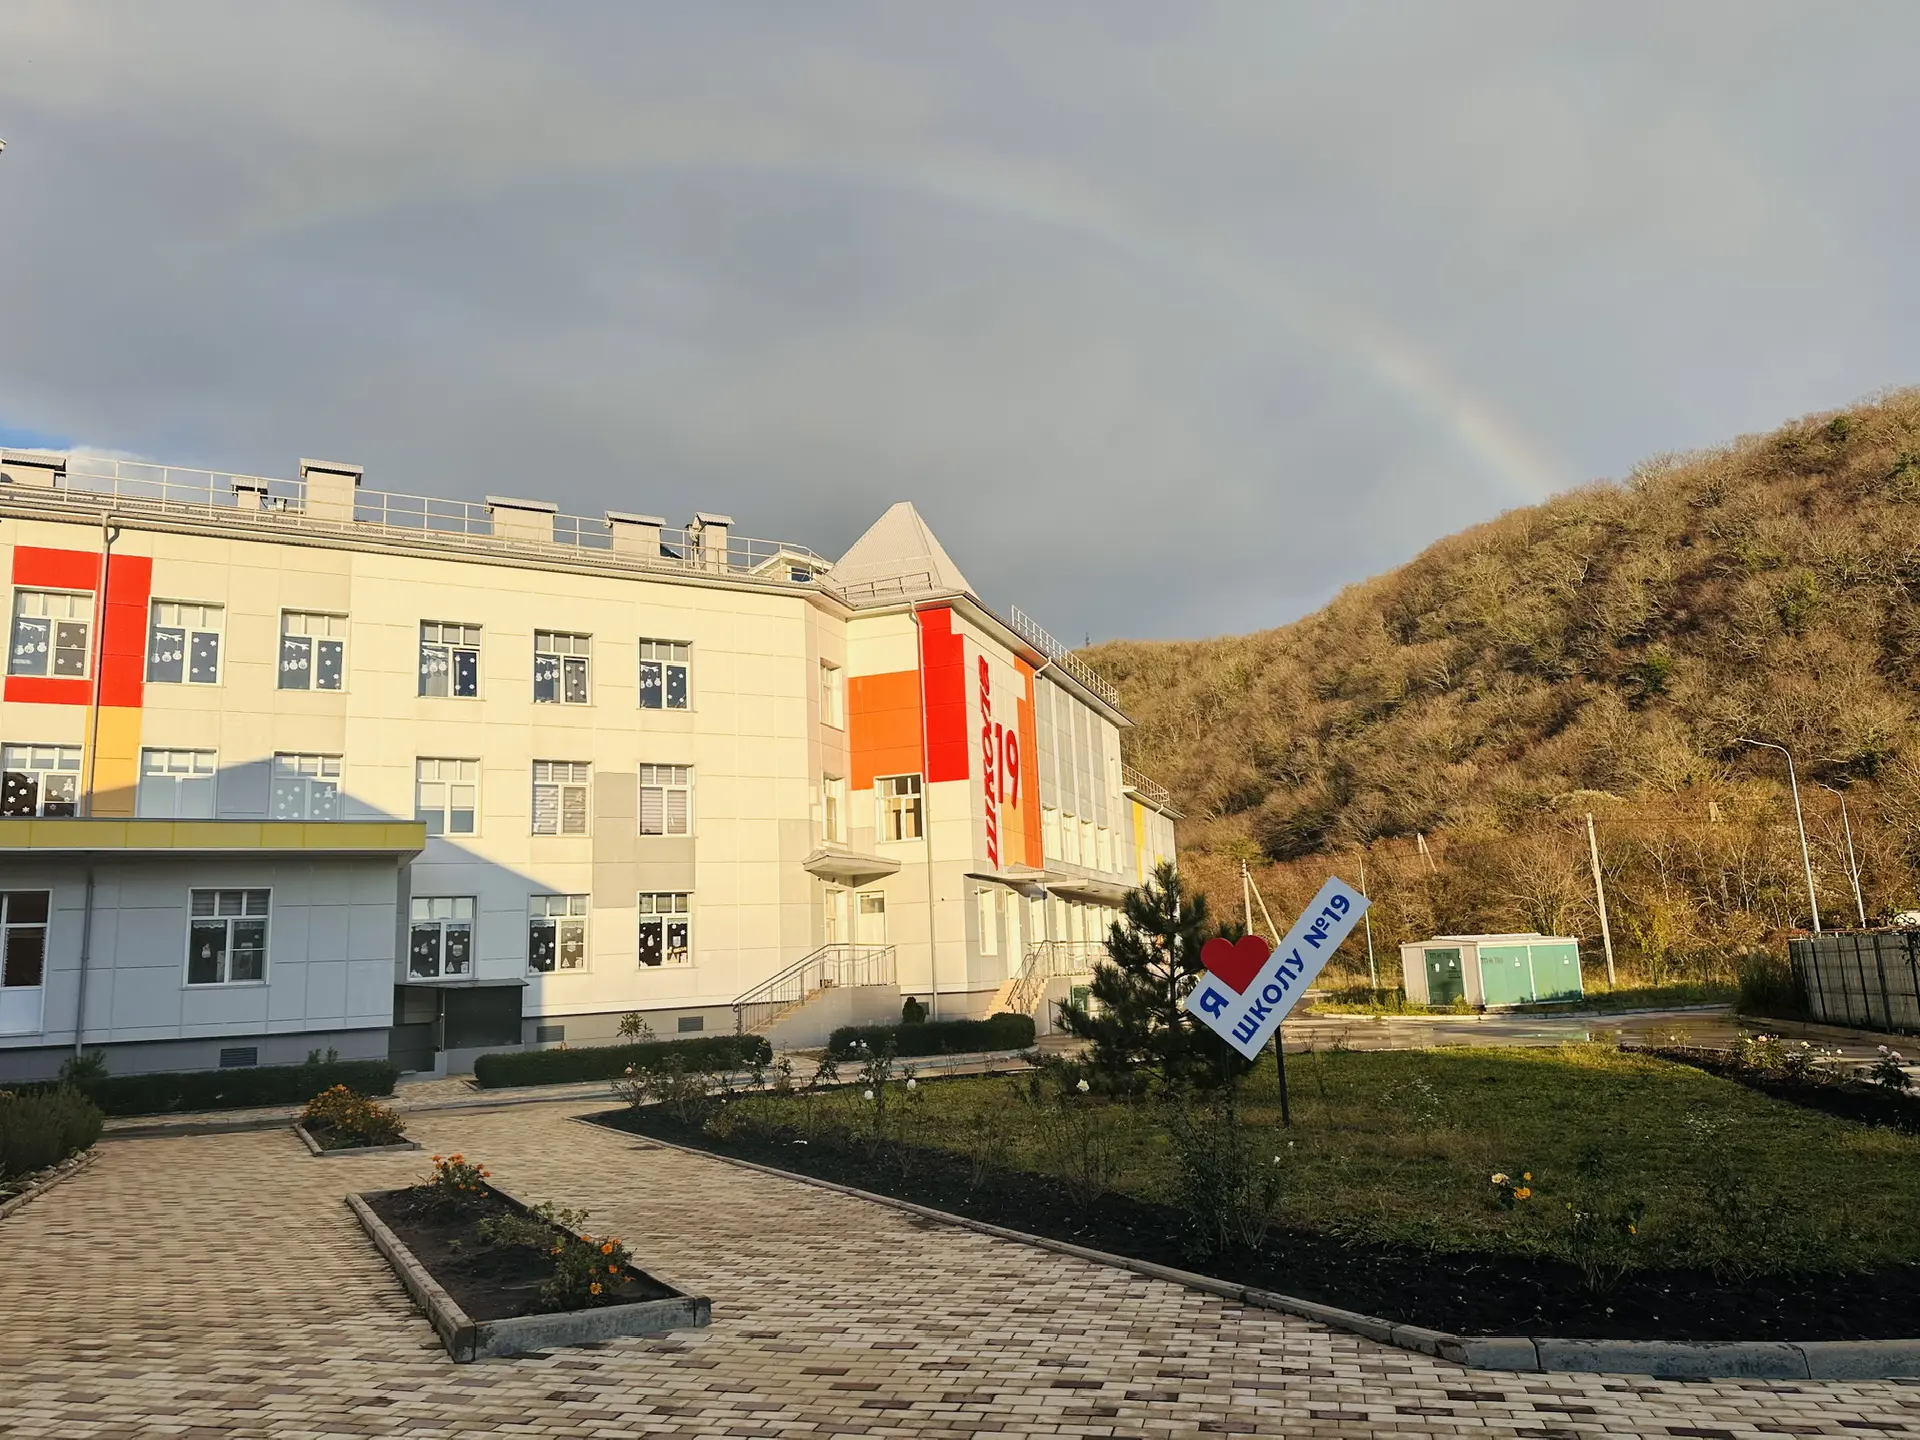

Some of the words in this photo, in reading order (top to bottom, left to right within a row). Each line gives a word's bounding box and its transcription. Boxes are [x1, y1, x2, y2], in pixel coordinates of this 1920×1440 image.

[995, 722, 1018, 810] 19
[1199, 986, 1230, 1020] Я
[1231, 948, 1305, 1045] ШКОЛУ
[1303, 894, 1350, 949] №19
